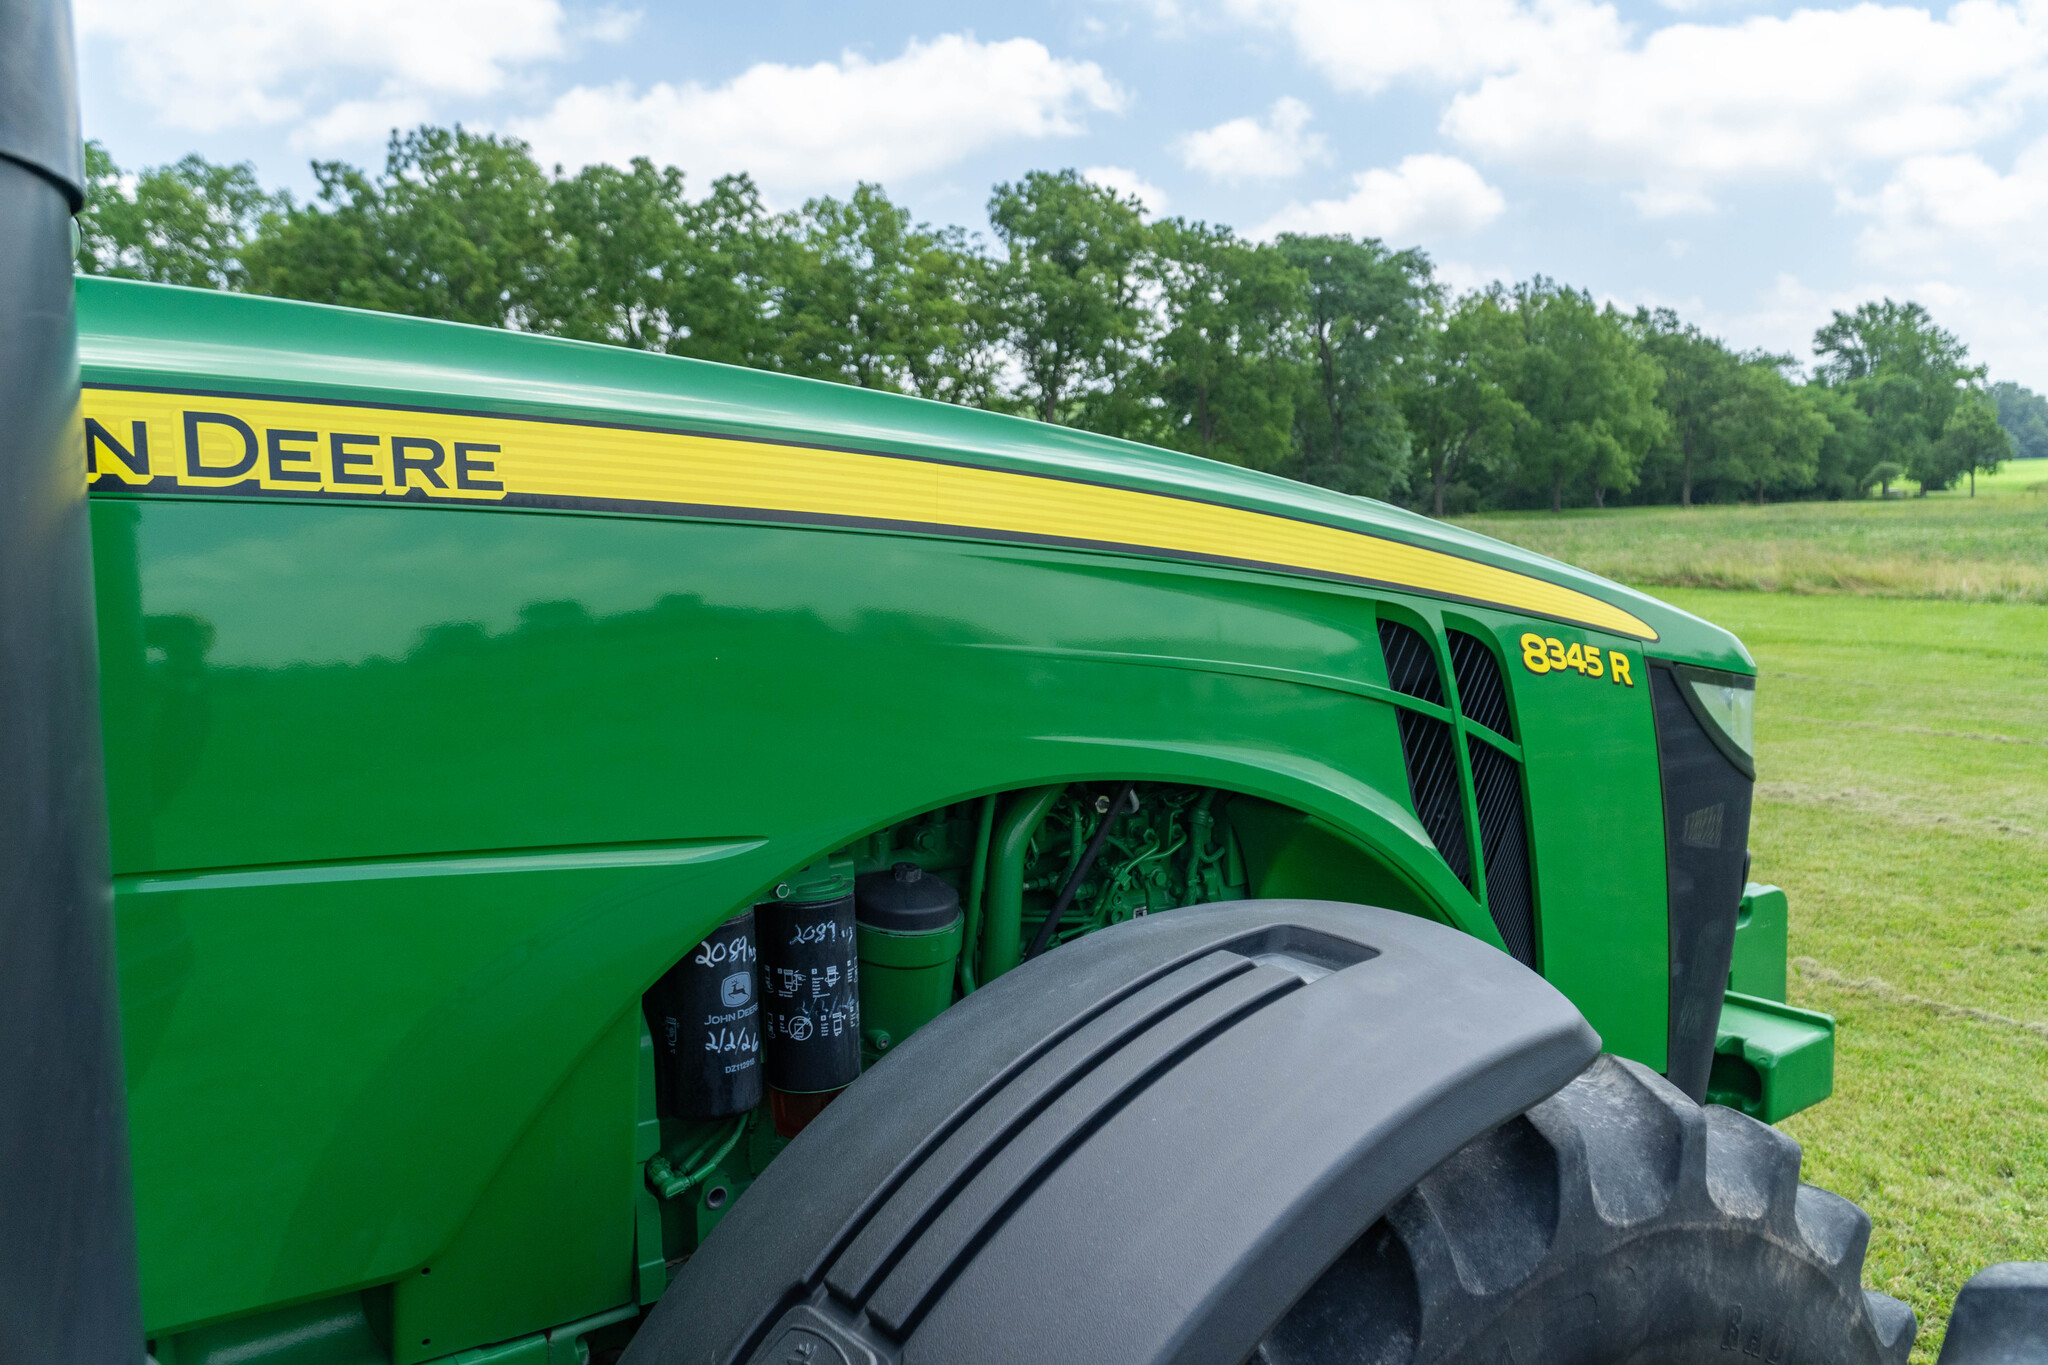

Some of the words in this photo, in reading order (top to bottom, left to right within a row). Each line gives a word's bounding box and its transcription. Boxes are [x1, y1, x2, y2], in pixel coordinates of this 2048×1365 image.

[182, 410, 504, 492] DEERE
[1520, 632, 1604, 677] 8345
[1608, 650, 1634, 688] R
[695, 935, 747, 968] 2089
[704, 1012, 736, 1026] JOHN
[705, 1026, 759, 1055] 2/2/26
